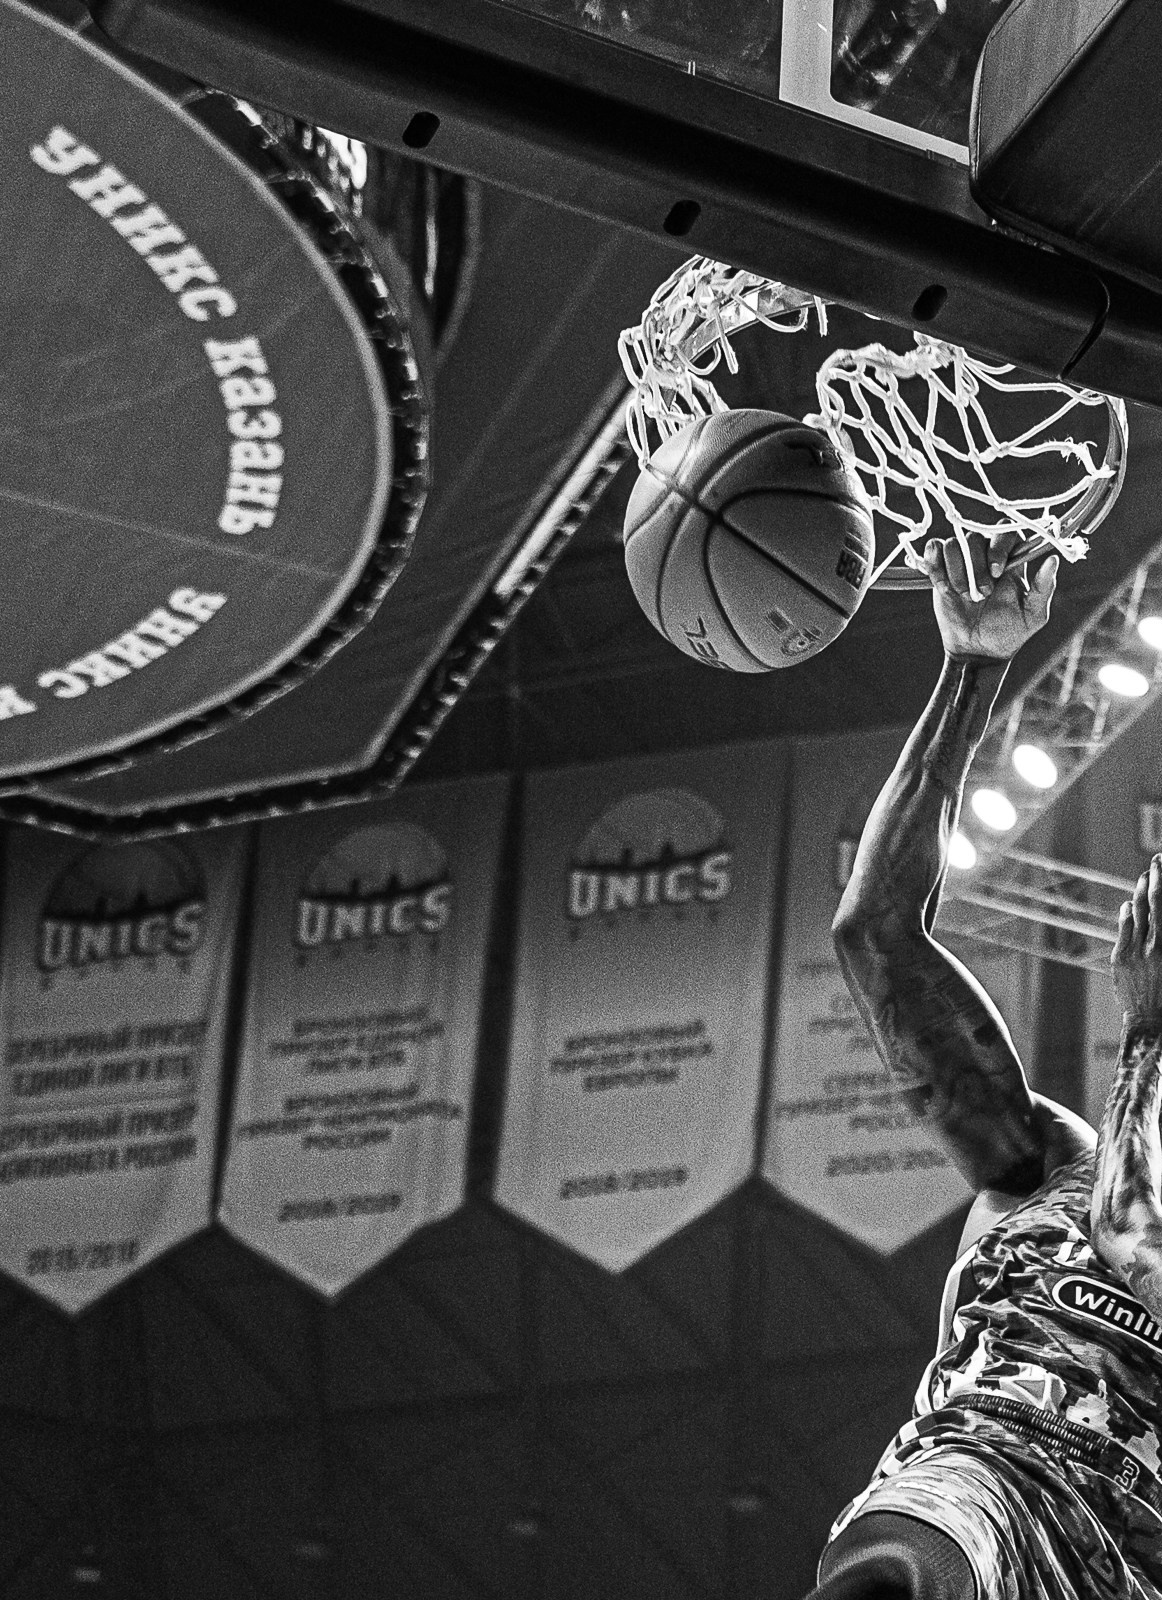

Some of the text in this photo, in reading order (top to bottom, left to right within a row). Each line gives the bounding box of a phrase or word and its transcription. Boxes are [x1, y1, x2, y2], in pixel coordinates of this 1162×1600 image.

[30, 126, 284, 535] УНИКС Казань
[300, 885, 453, 946] UNICS
[568, 850, 731, 918] UNICS
[38, 904, 201, 971] UNICS
